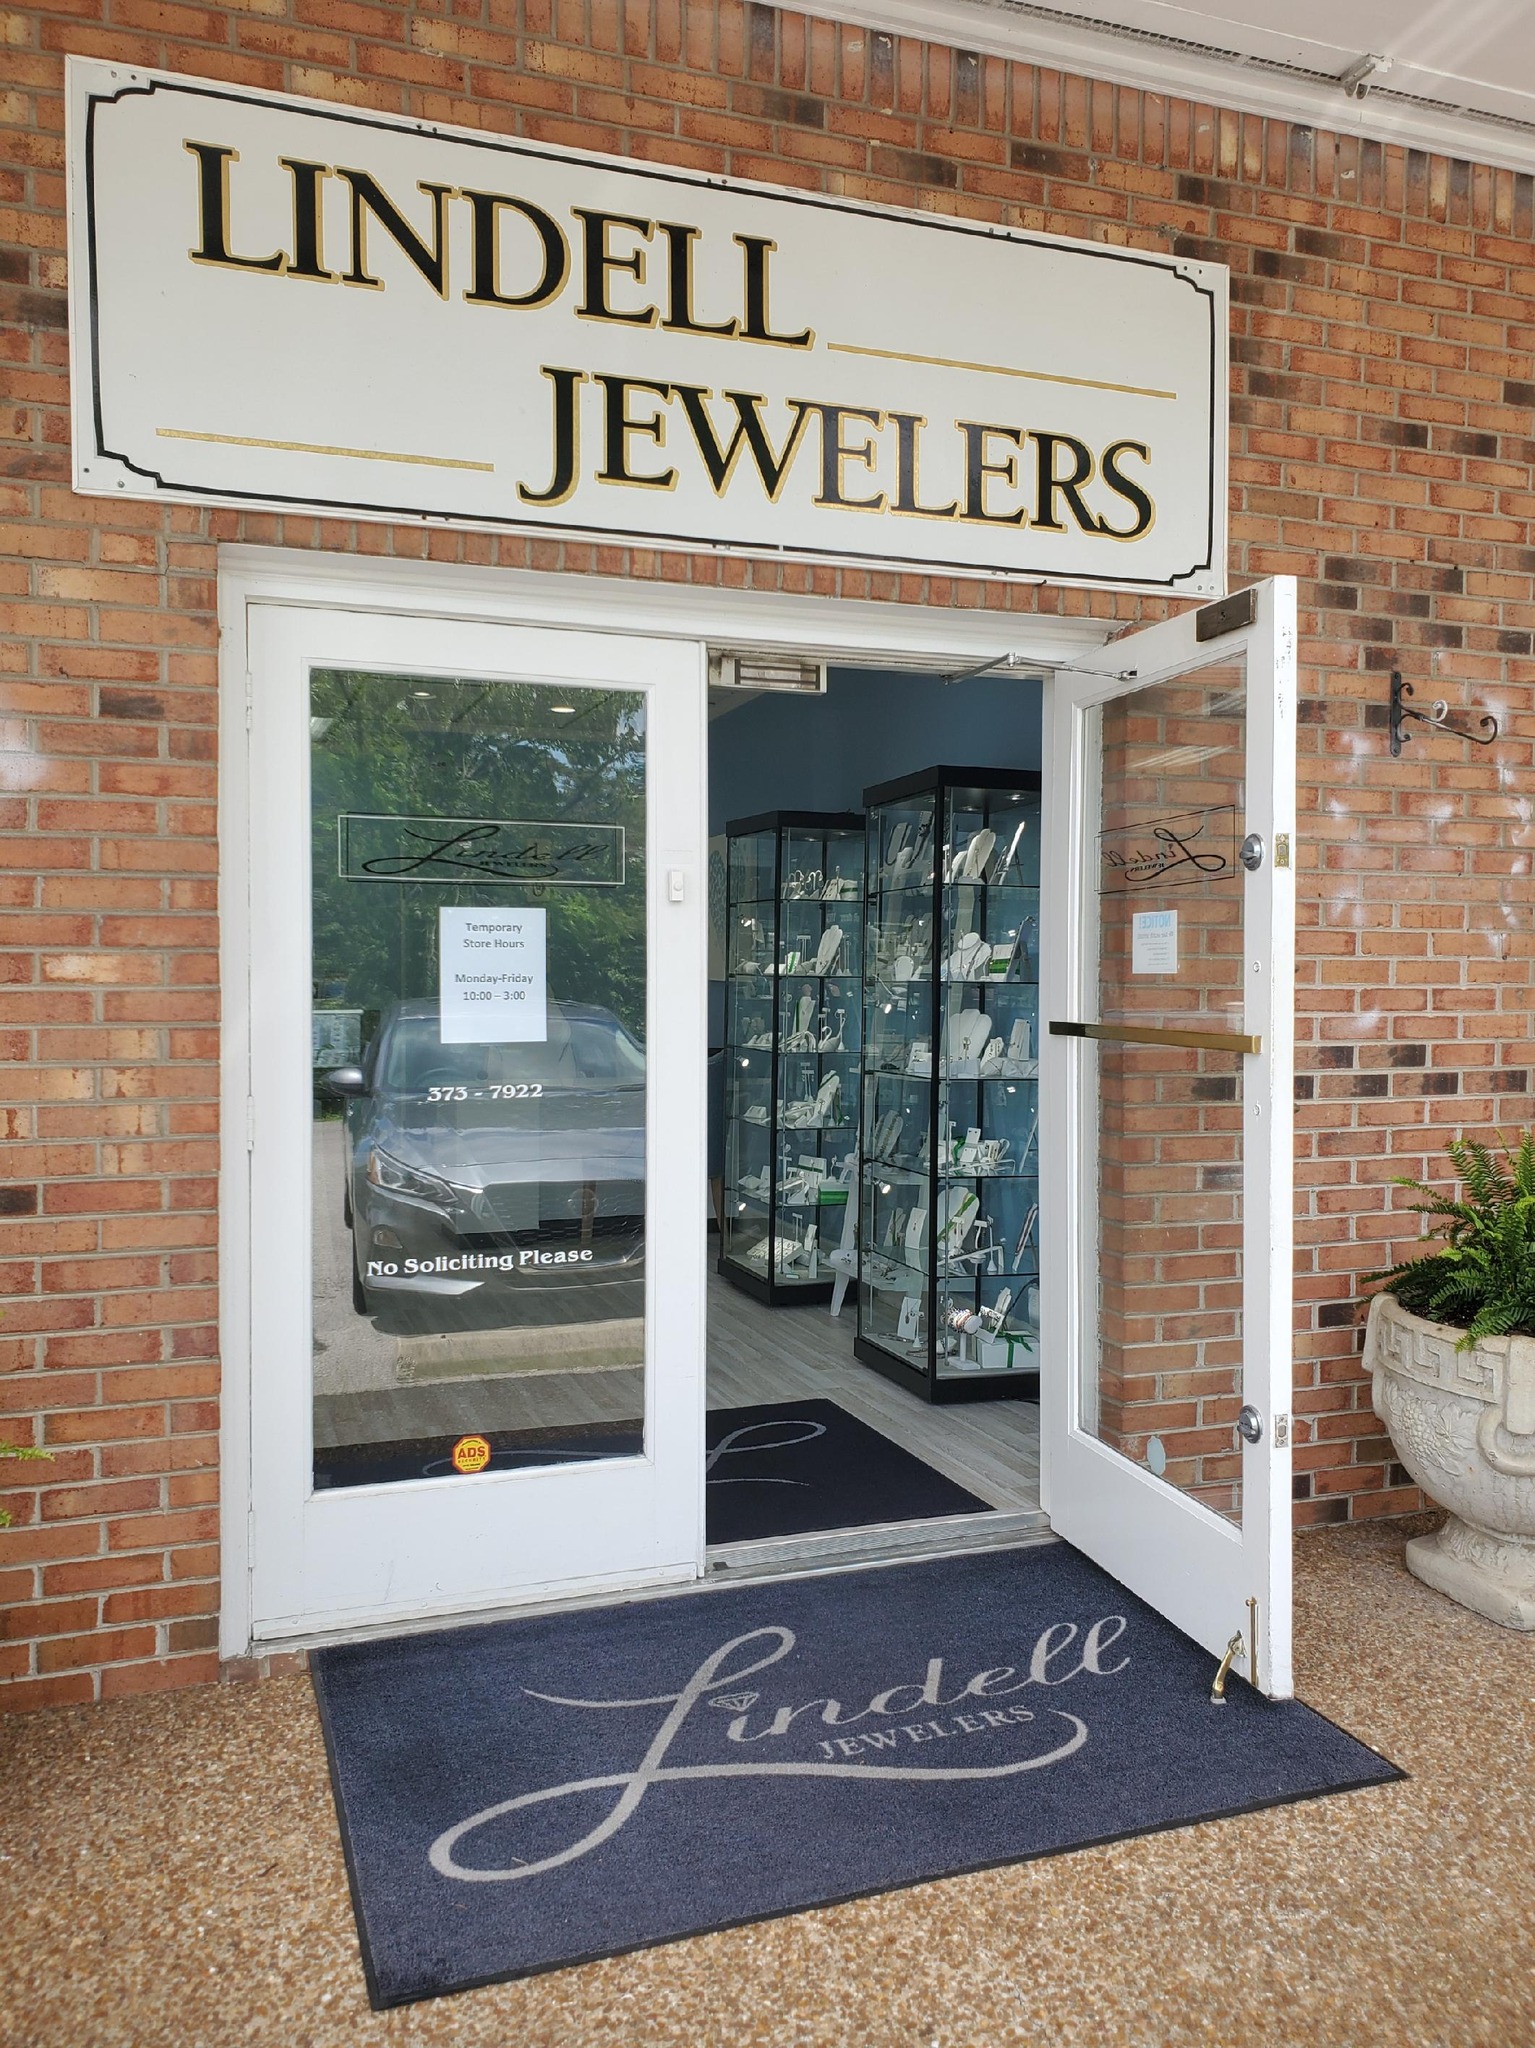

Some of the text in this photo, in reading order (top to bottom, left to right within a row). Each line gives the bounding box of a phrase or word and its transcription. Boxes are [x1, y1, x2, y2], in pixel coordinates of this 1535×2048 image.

[182, 139, 816, 351] LINDELL
[516, 365, 1156, 543] JEWELERS
[362, 825, 609, 878] Lindell
[465, 922, 523, 934] Temporary
[463, 939, 525, 949] Store Hours
[455, 973, 534, 985] Monday-Friday
[463, 990, 492, 1001] 10:00
[503, 990, 526, 1001] 3:00
[427, 1086, 469, 1102] 373
[489, 1083, 544, 1099] 7922
[366, 1248, 593, 1276] No Soliciting Please
[458, 1445, 486, 1459] ADS
[818, 1704, 1036, 1760] JEWELERS
[428, 1615, 1131, 1882] Lindell
